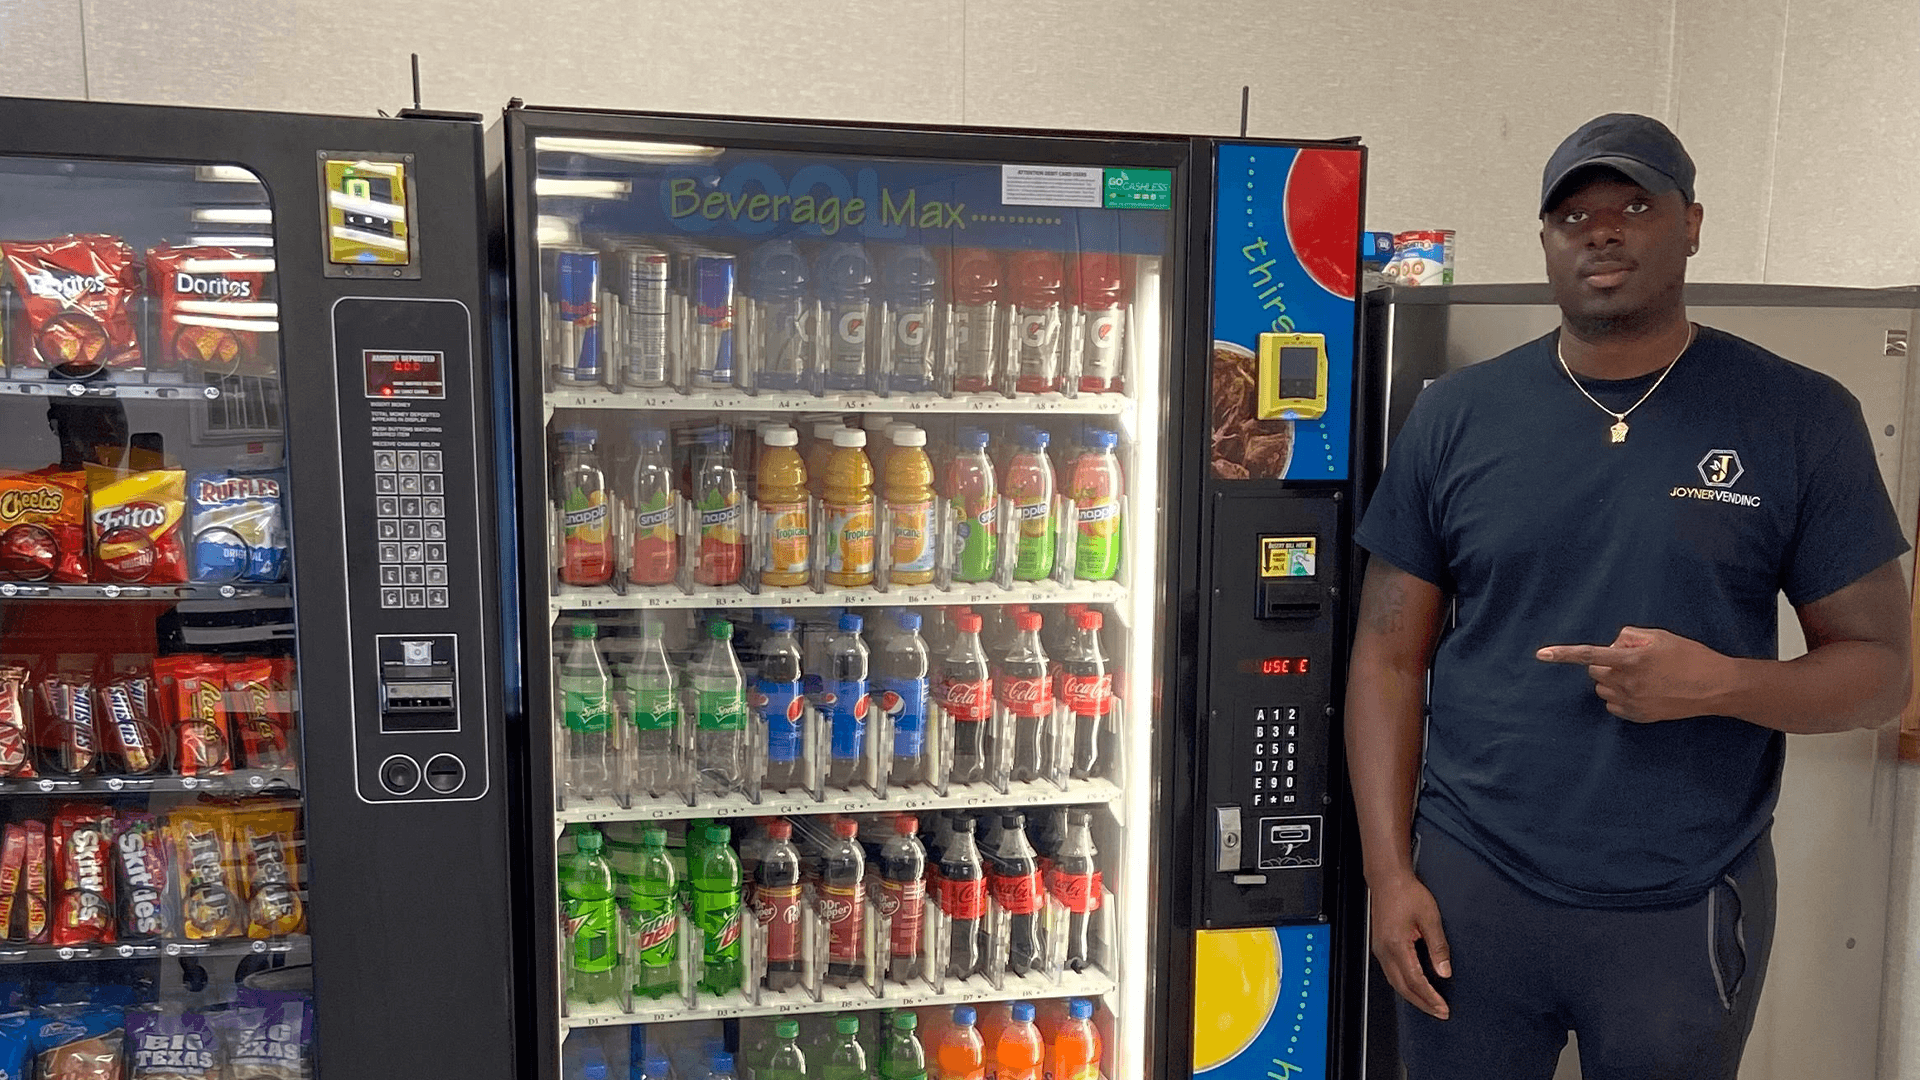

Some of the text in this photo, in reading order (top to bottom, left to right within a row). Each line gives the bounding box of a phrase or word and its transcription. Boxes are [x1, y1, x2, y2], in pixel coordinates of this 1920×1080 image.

[670, 178, 866, 236] Beverage
[882, 188, 966, 231] Max
[177, 273, 250, 297] Doritos
[574, 397, 586, 406] A1
[645, 398, 657, 407] A2
[712, 400, 724, 408] A3
[778, 400, 790, 409] A4
[844, 401, 857, 409] A5
[1711, 455, 1734, 483] J
[201, 479, 280, 503] RUFFLES
[1, 487, 64, 521] Cheetos
[94, 505, 166, 530] Fritos
[702, 504, 742, 525] napple
[1079, 503, 1119, 521] napple
[775, 527, 809, 541] Tropican
[581, 600, 592, 608] B1
[716, 598, 727, 606] B3
[781, 597, 792, 605] B4
[1263, 659, 1289, 673] USE
[1257, 708, 1296, 721] A 1 2
[1256, 725, 1296, 738] B 3 4
[1256, 742, 1295, 755] C 5 6
[1255, 760, 1294, 772] D 7 8
[1255, 776, 1294, 789] E 9 0
[1254, 794, 1261, 806] F
[72, 829, 104, 922] Skittles
[827, 900, 840, 909] Dr
[653, 1013, 665, 1021] D2
[717, 1009, 728, 1017] D3
[588, 1017, 599, 1026] D1
[136, 1050, 214, 1069] TEXAS
